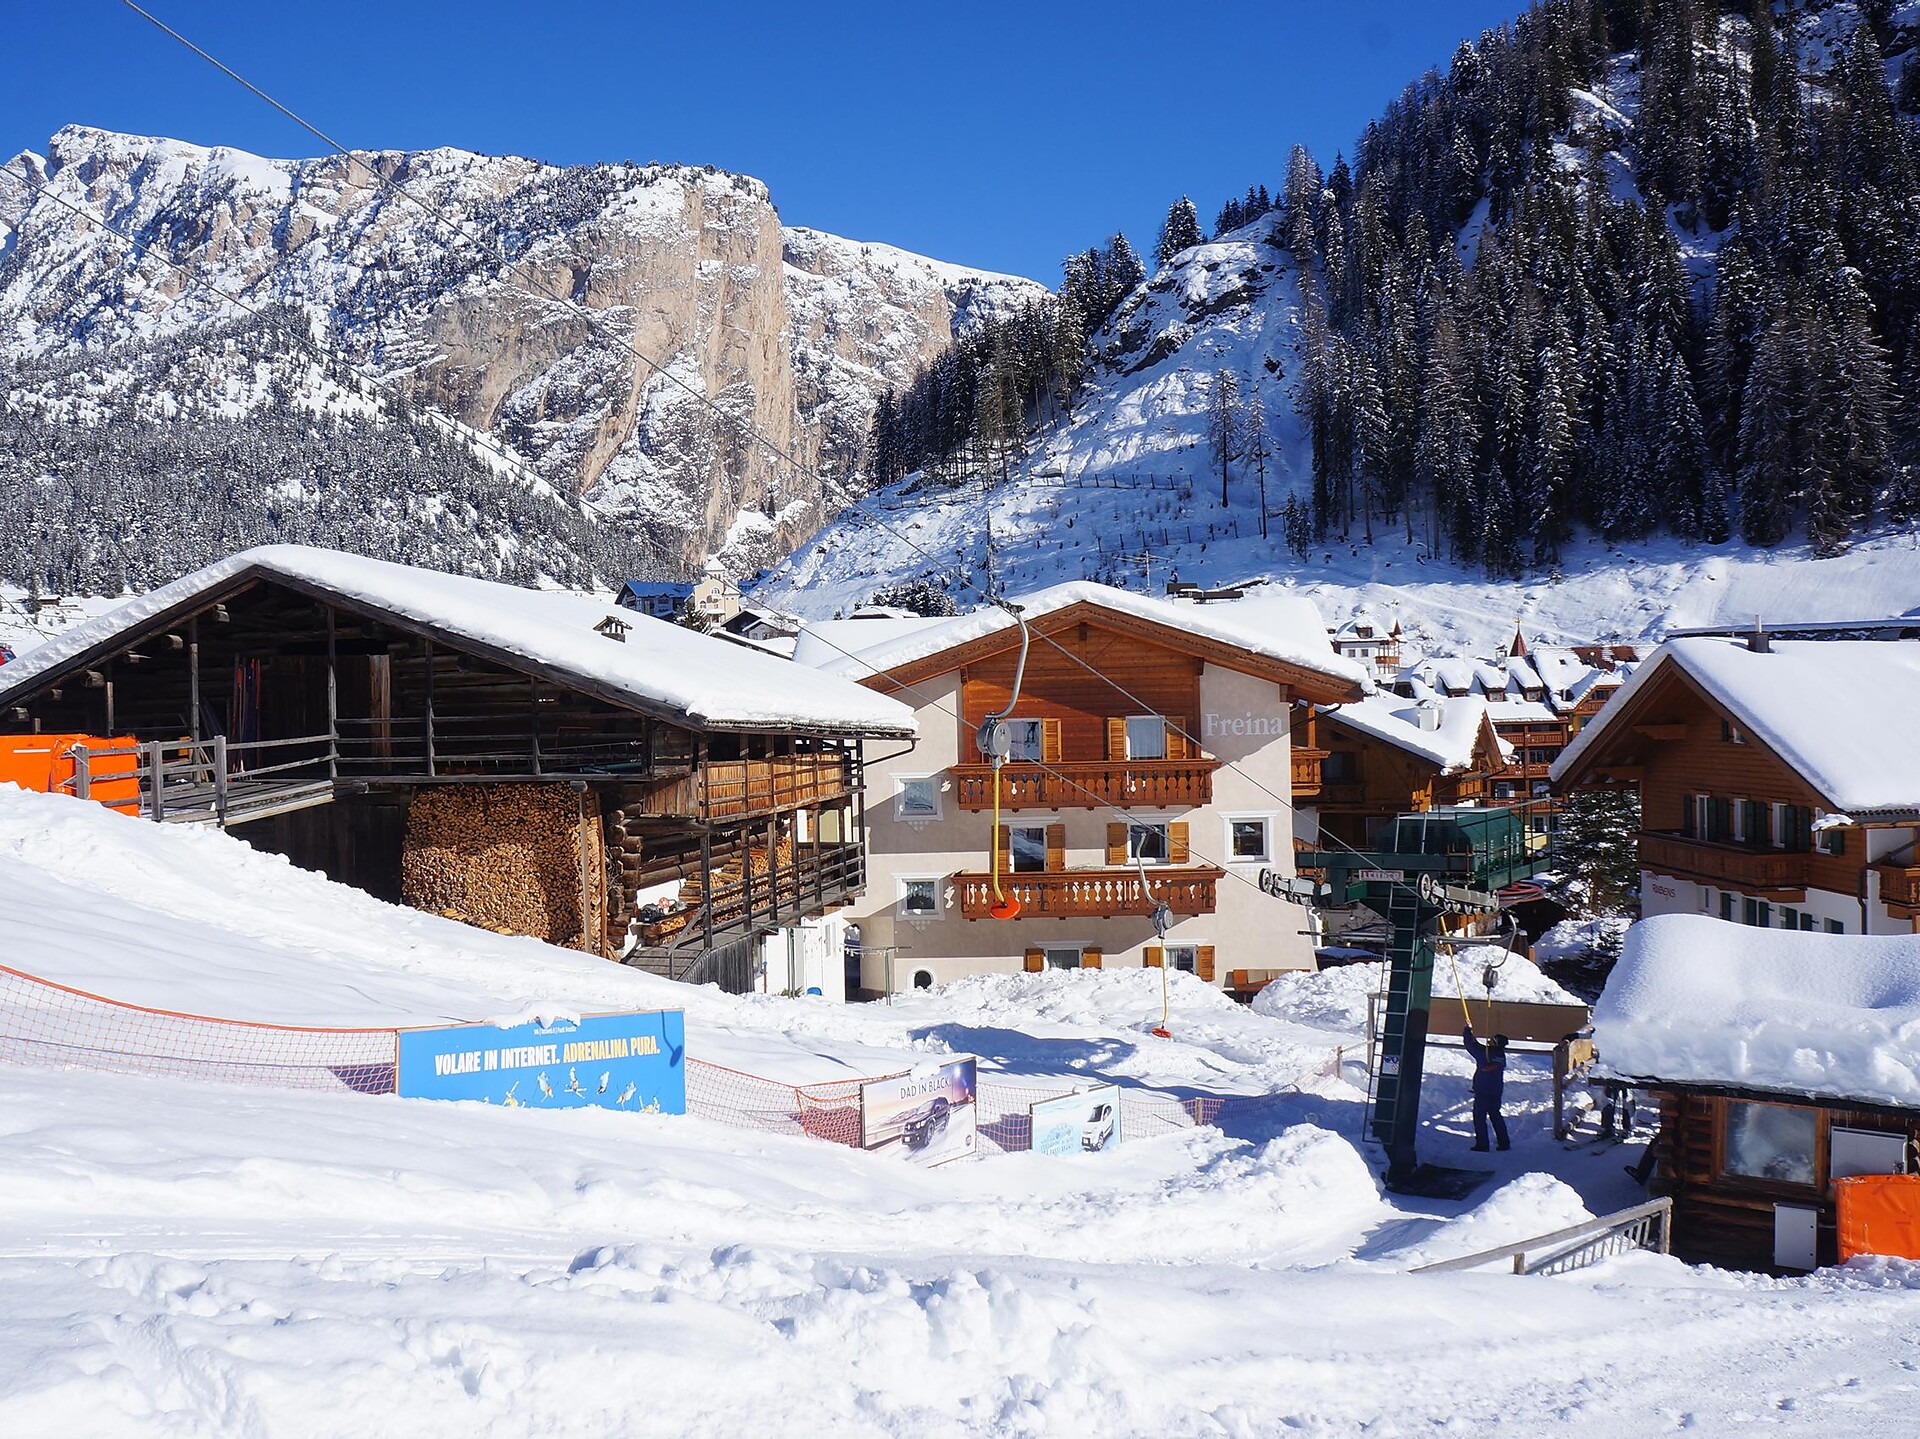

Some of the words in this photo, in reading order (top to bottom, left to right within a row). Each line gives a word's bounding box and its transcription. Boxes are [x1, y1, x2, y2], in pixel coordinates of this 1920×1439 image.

[1204, 711, 1284, 736] Freina
[434, 1050, 482, 1076] VOLARE
[483, 1049, 498, 1071] IN
[500, 1044, 560, 1070] INTERNET.
[562, 1038, 629, 1064] ADRENALINA
[630, 1035, 661, 1057] PURA.
[900, 1085, 917, 1099] DAD
[918, 1083, 927, 1095] IN
